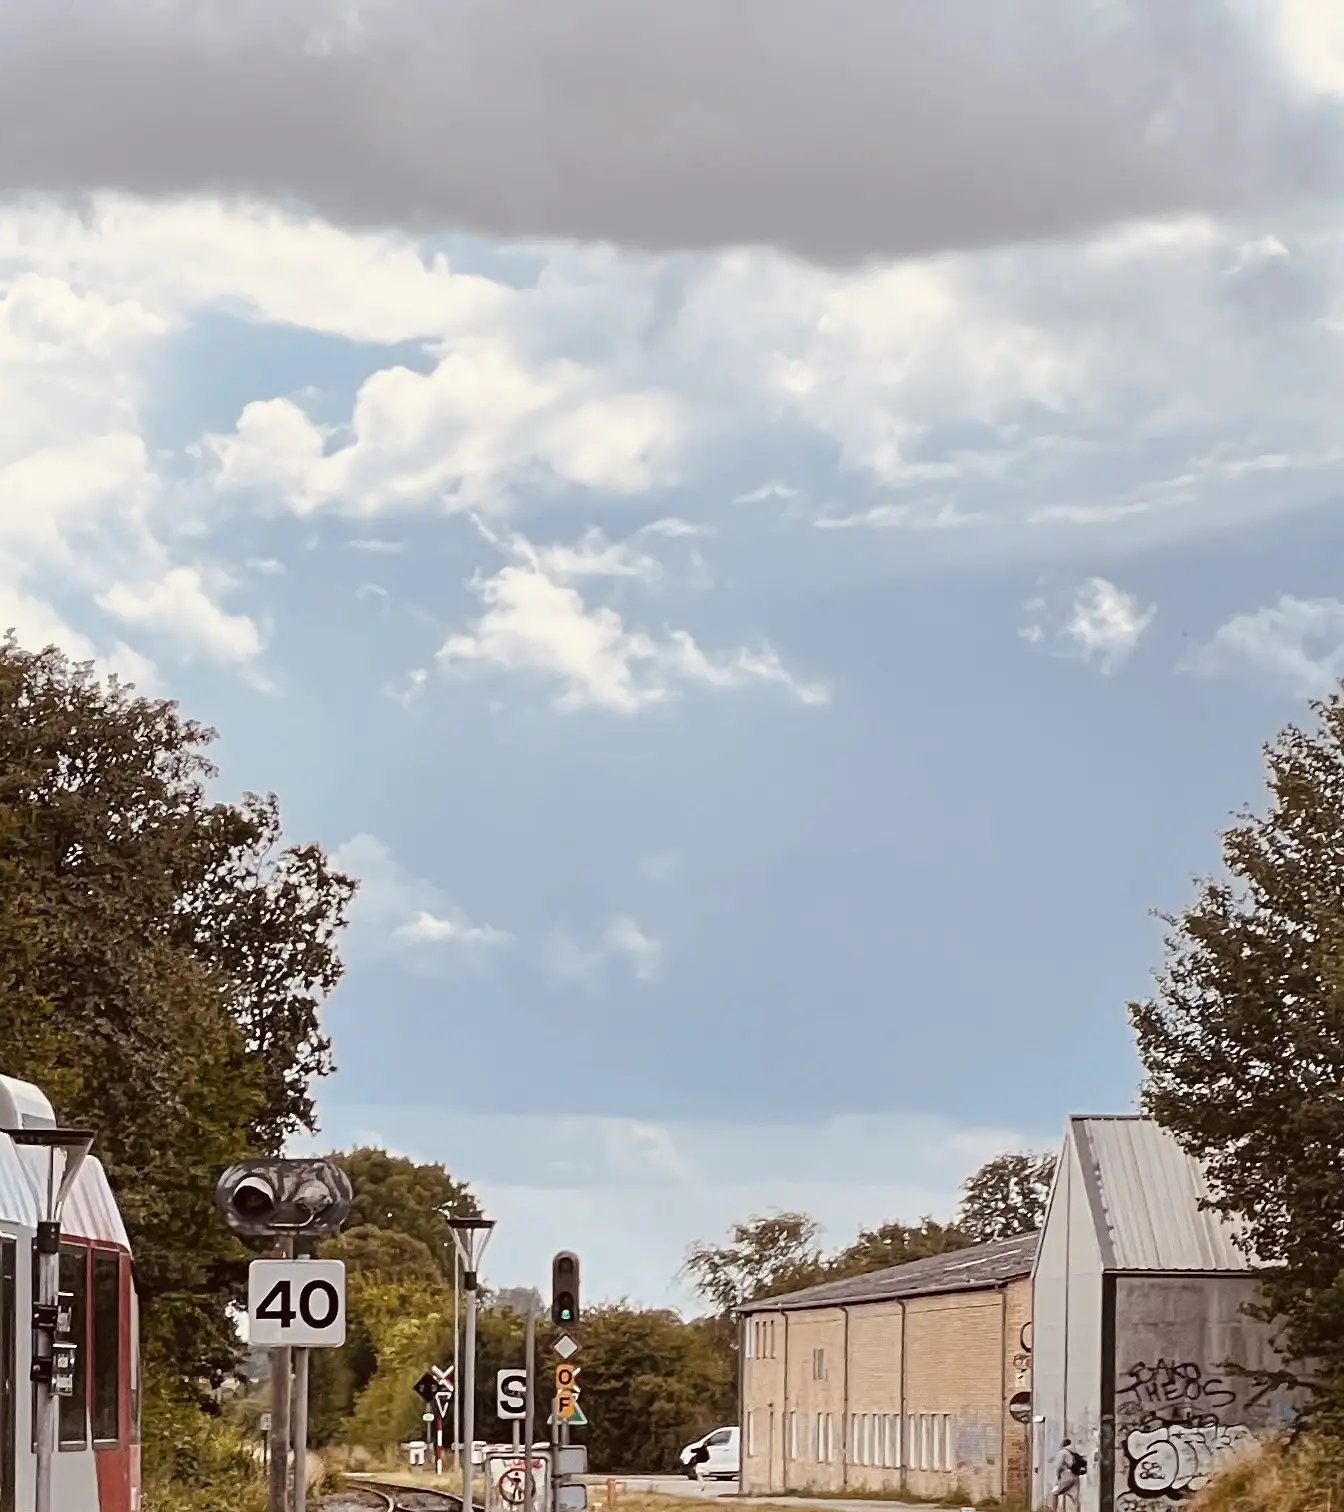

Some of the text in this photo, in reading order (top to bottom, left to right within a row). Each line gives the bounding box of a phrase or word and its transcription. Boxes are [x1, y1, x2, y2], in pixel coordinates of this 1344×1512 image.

[255, 1279, 339, 1329] 40
[558, 1368, 572, 1385] O
[500, 1375, 526, 1413] S
[558, 1396, 570, 1413] F
